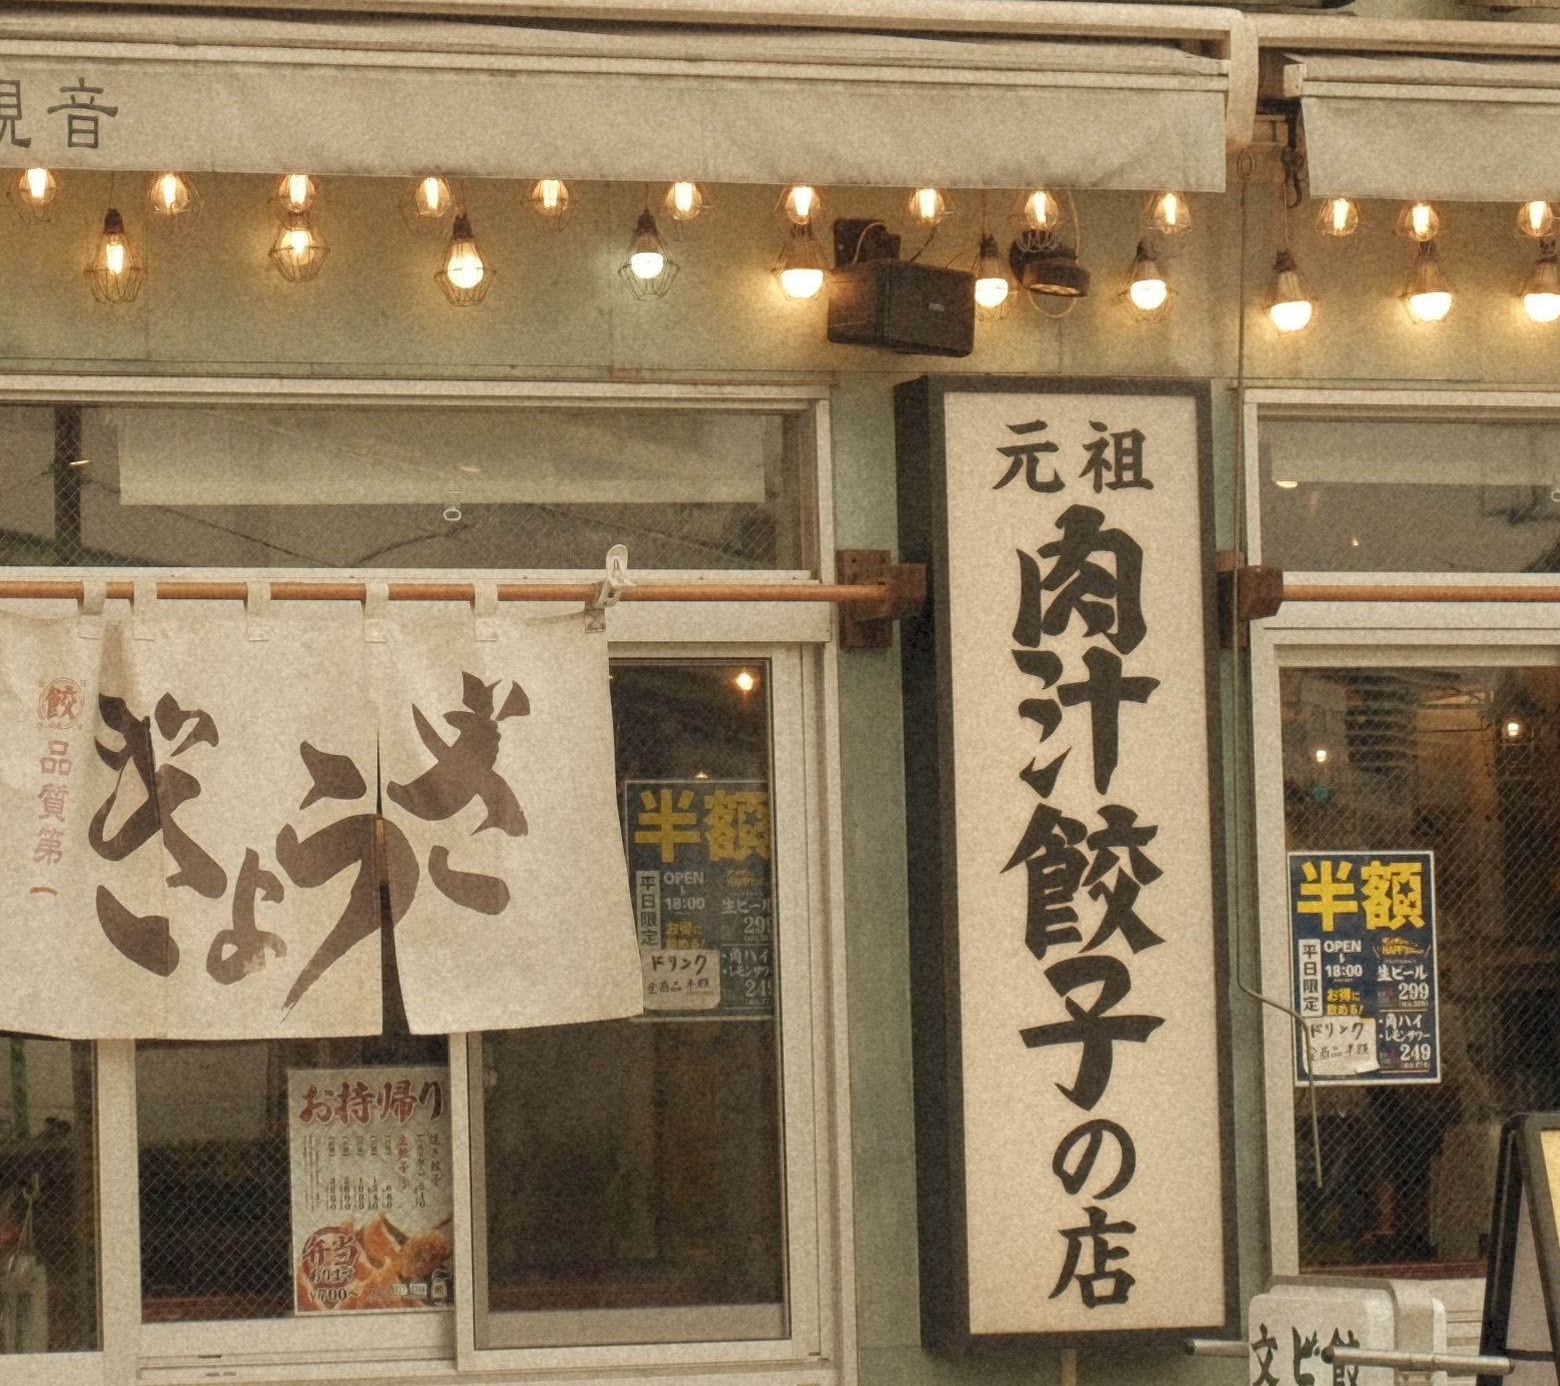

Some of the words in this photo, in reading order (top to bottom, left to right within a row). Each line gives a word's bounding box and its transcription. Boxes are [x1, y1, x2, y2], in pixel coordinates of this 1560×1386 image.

[992, 419, 1154, 494] 元祖
[30, 739, 74, 897] 品質第一
[635, 789, 770, 862] 半額
[87, 670, 532, 1022] ぎょうざ
[664, 872, 705, 885] OPEN
[665, 897, 706, 910] 18:00
[1000, 503, 1166, 1309] 肉汁餃子の店
[1297, 860, 1426, 932] 半額
[1323, 940, 1362, 953] OPEN
[651, 955, 707, 975] ドリンク
[1302, 944, 1318, 1012] 平日限定
[1325, 964, 1363, 978] 18:00
[1377, 964, 1428, 982] 生ビール
[1398, 982, 1429, 1001] 299
[1399, 1043, 1431, 1061] 249
[298, 1079, 443, 1125] お持帰り
